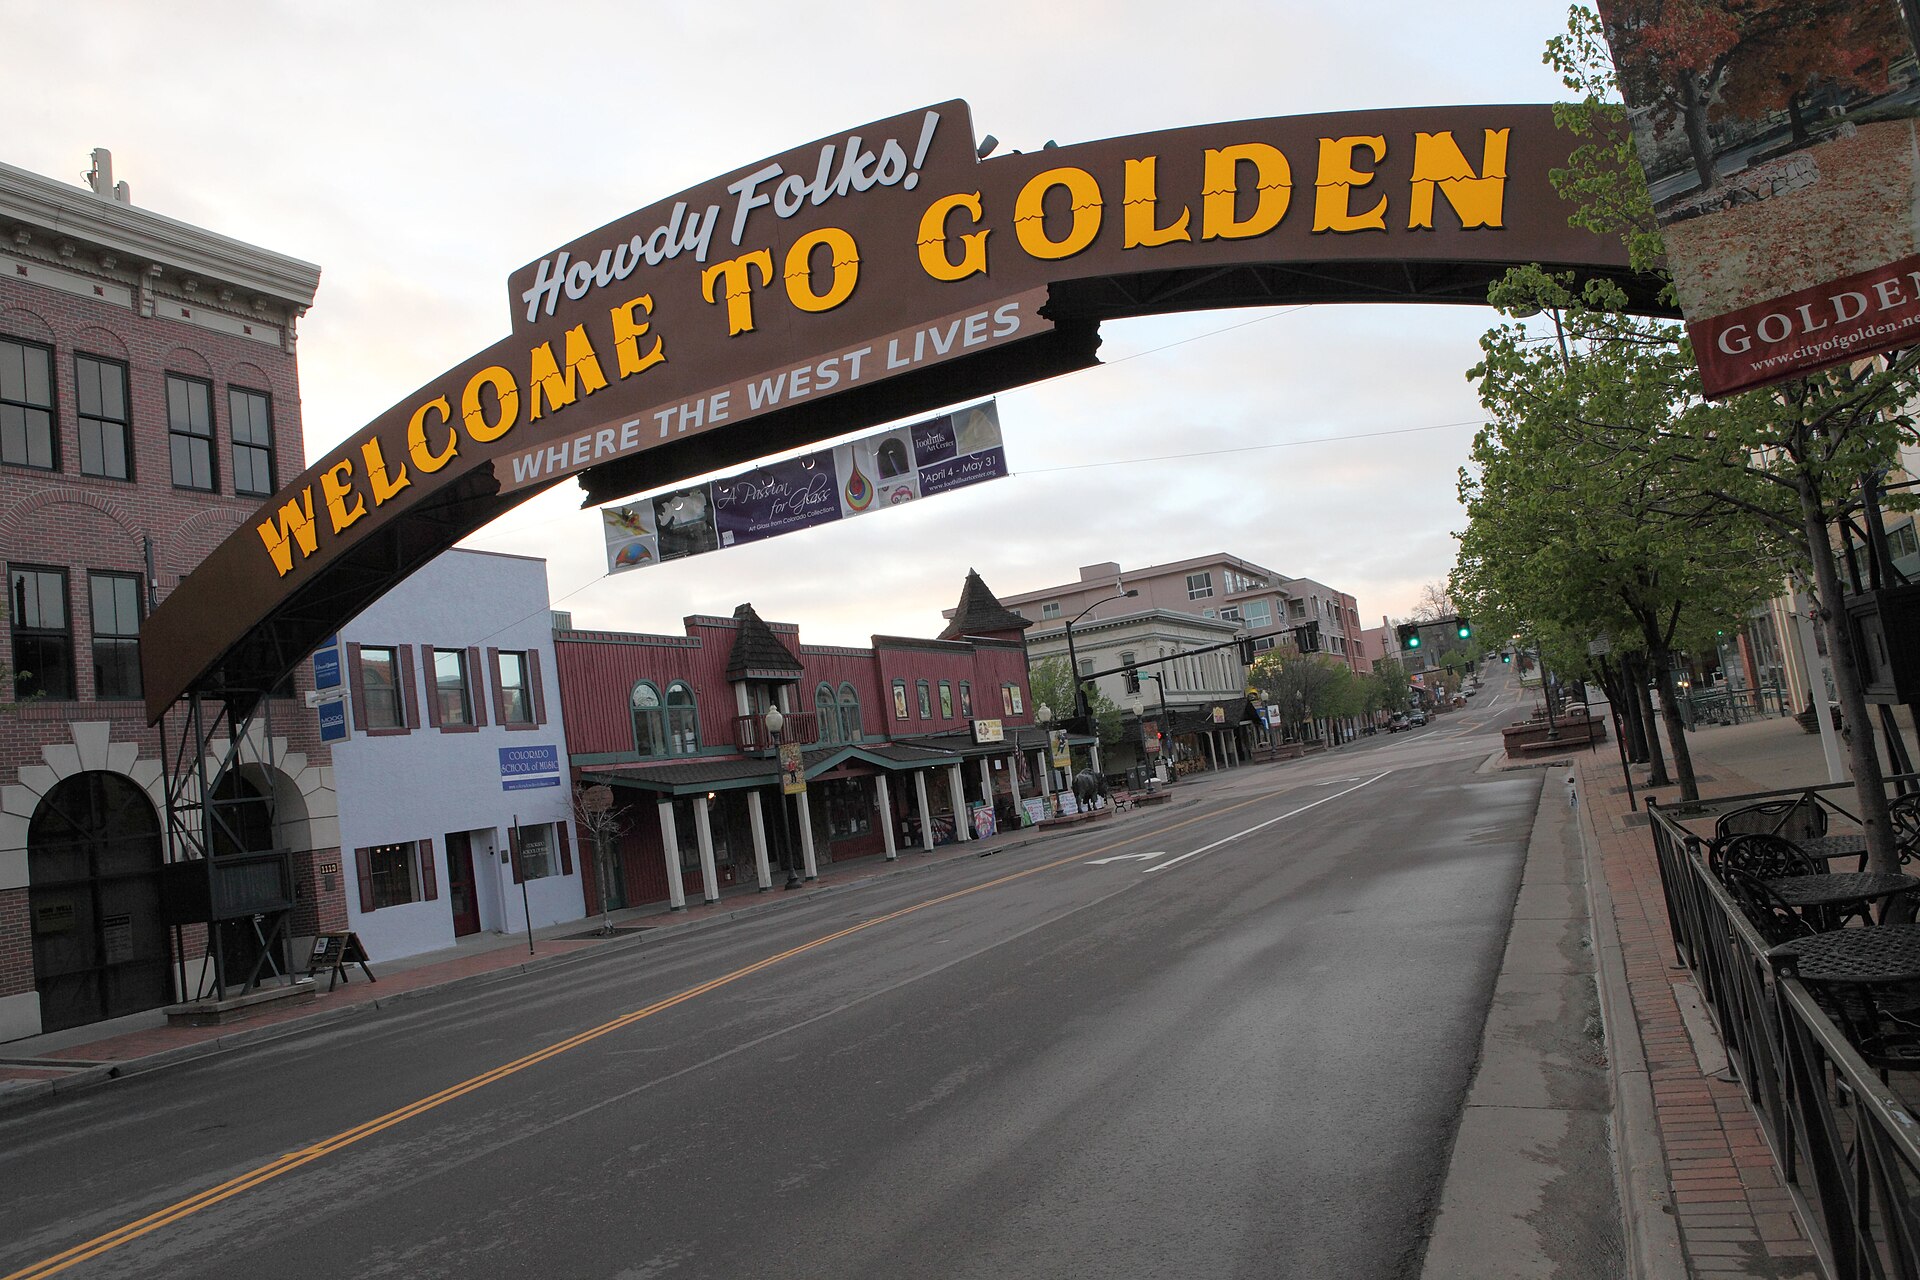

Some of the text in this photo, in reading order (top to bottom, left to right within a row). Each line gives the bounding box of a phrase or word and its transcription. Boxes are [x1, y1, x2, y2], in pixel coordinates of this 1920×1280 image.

[523, 111, 939, 322] Howdy Folks!
[256, 128, 1511, 578] WELCOME TO GOLDEN
[512, 303, 1021, 484] WHERE THE WEST LIVES
[916, 433, 945, 449] Foothills
[926, 440, 954, 452] Art Center
[925, 468, 946, 483] April
[948, 468, 953, 476] 4
[962, 460, 983, 473] May
[986, 455, 996, 466] 31
[717, 482, 792, 509] A Passion
[769, 473, 831, 520] for Glass
[783, 513, 806, 524] Colorado
[807, 506, 834, 518] Collections
[509, 750, 549, 760] COLORADO
[501, 762, 530, 773] SCHOOL
[539, 761, 559, 770] MUSIC
[321, 864, 336, 874] 1113
